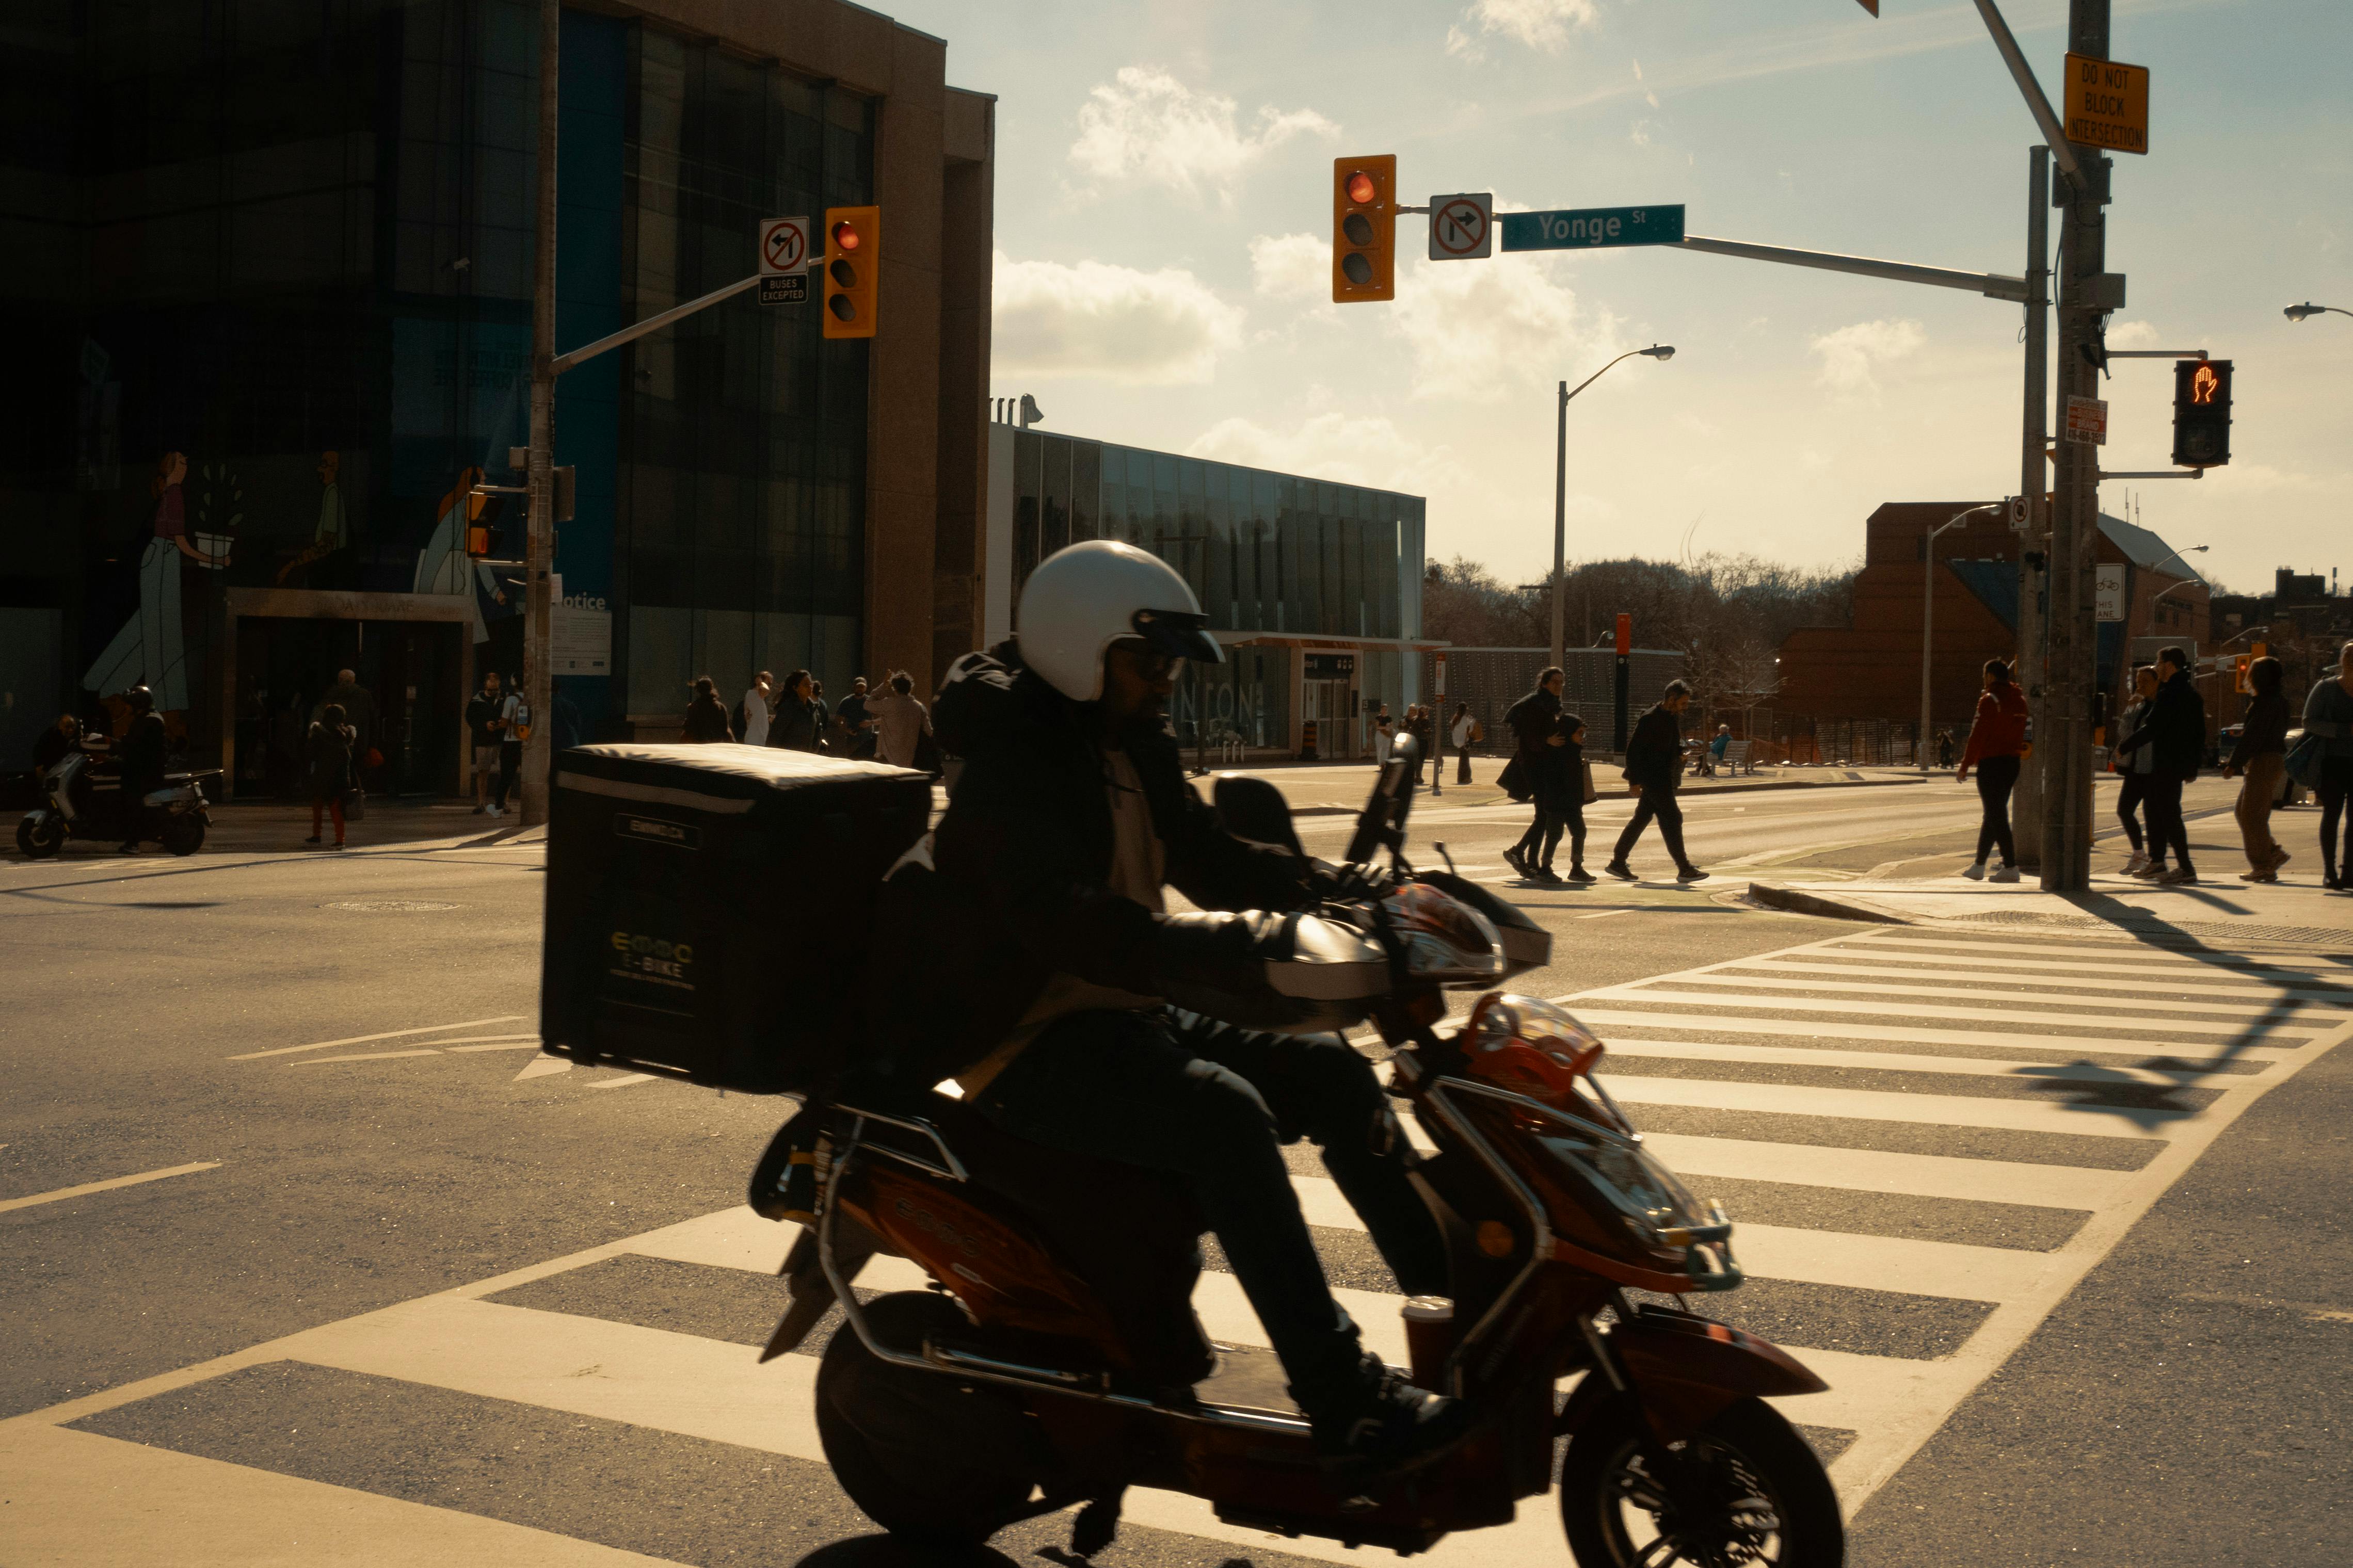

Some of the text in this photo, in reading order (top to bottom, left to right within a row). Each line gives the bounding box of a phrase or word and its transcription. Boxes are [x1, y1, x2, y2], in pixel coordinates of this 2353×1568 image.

[2082, 63, 2129, 90] DO NOT
[2085, 91, 2124, 117] BLOCK
[2069, 117, 2142, 148] INTERSECTION
[1539, 210, 1646, 244] Yonge St
[762, 289, 804, 301] EXCEPTED
[770, 279, 797, 289] BUSES
[563, 591, 606, 610] otice
[2095, 601, 2113, 609] HIS
